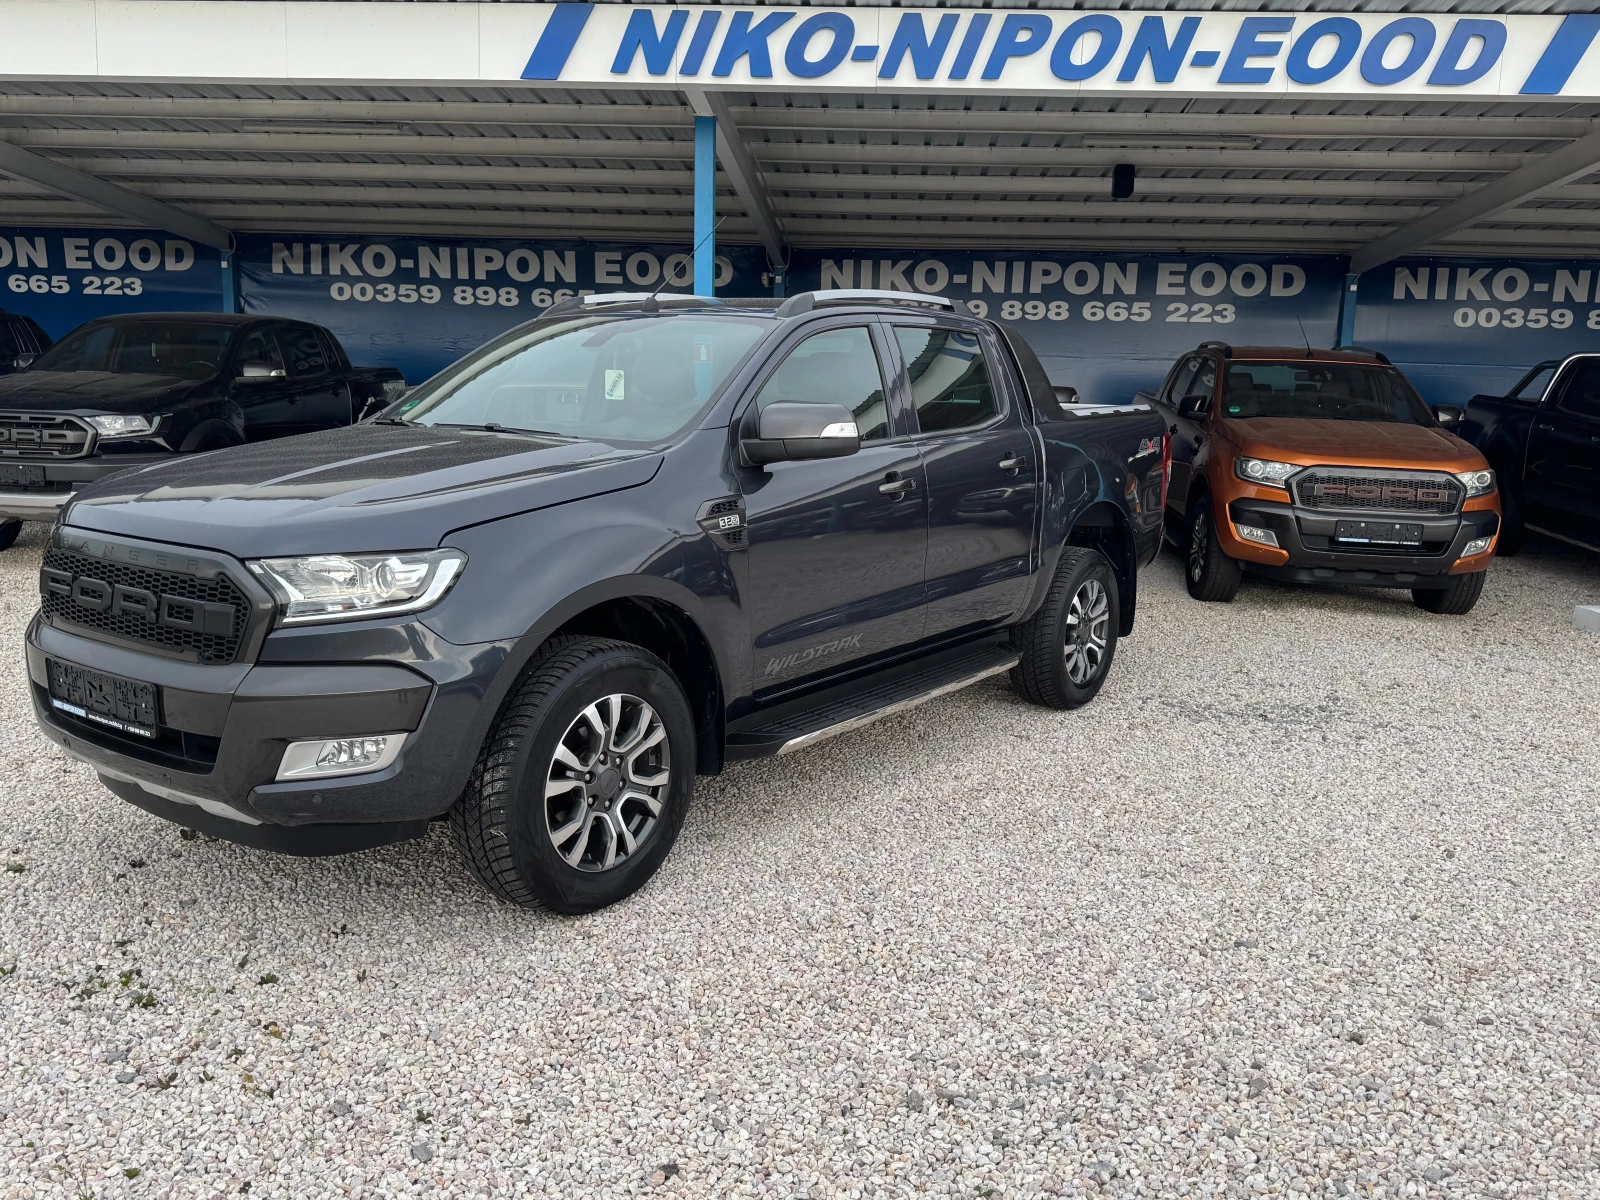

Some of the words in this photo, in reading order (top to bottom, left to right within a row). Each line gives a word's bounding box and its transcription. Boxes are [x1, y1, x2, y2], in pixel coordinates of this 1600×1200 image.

[611, 10, 1506, 84] NIKO-NIPON-EOOD
[64, 239, 194, 271] EOOD
[271, 243, 577, 283] NIKO-NIPON
[8, 274, 70, 294] 665
[82, 276, 143, 296] 223
[330, 282, 442, 304] 00359
[453, 285, 520, 307] 898
[820, 258, 1137, 295] NIKO-NIPON
[1156, 263, 1306, 297] EOOD
[1001, 300, 1070, 321] 898
[1081, 301, 1151, 323] 665
[1163, 303, 1236, 324] 223
[1453, 307, 1574, 329] 00359
[1314, 483, 1448, 502] FORD
[61, 535, 199, 573] RANGER
[40, 566, 208, 632] FORD
[764, 633, 865, 676] WILDTRAK
